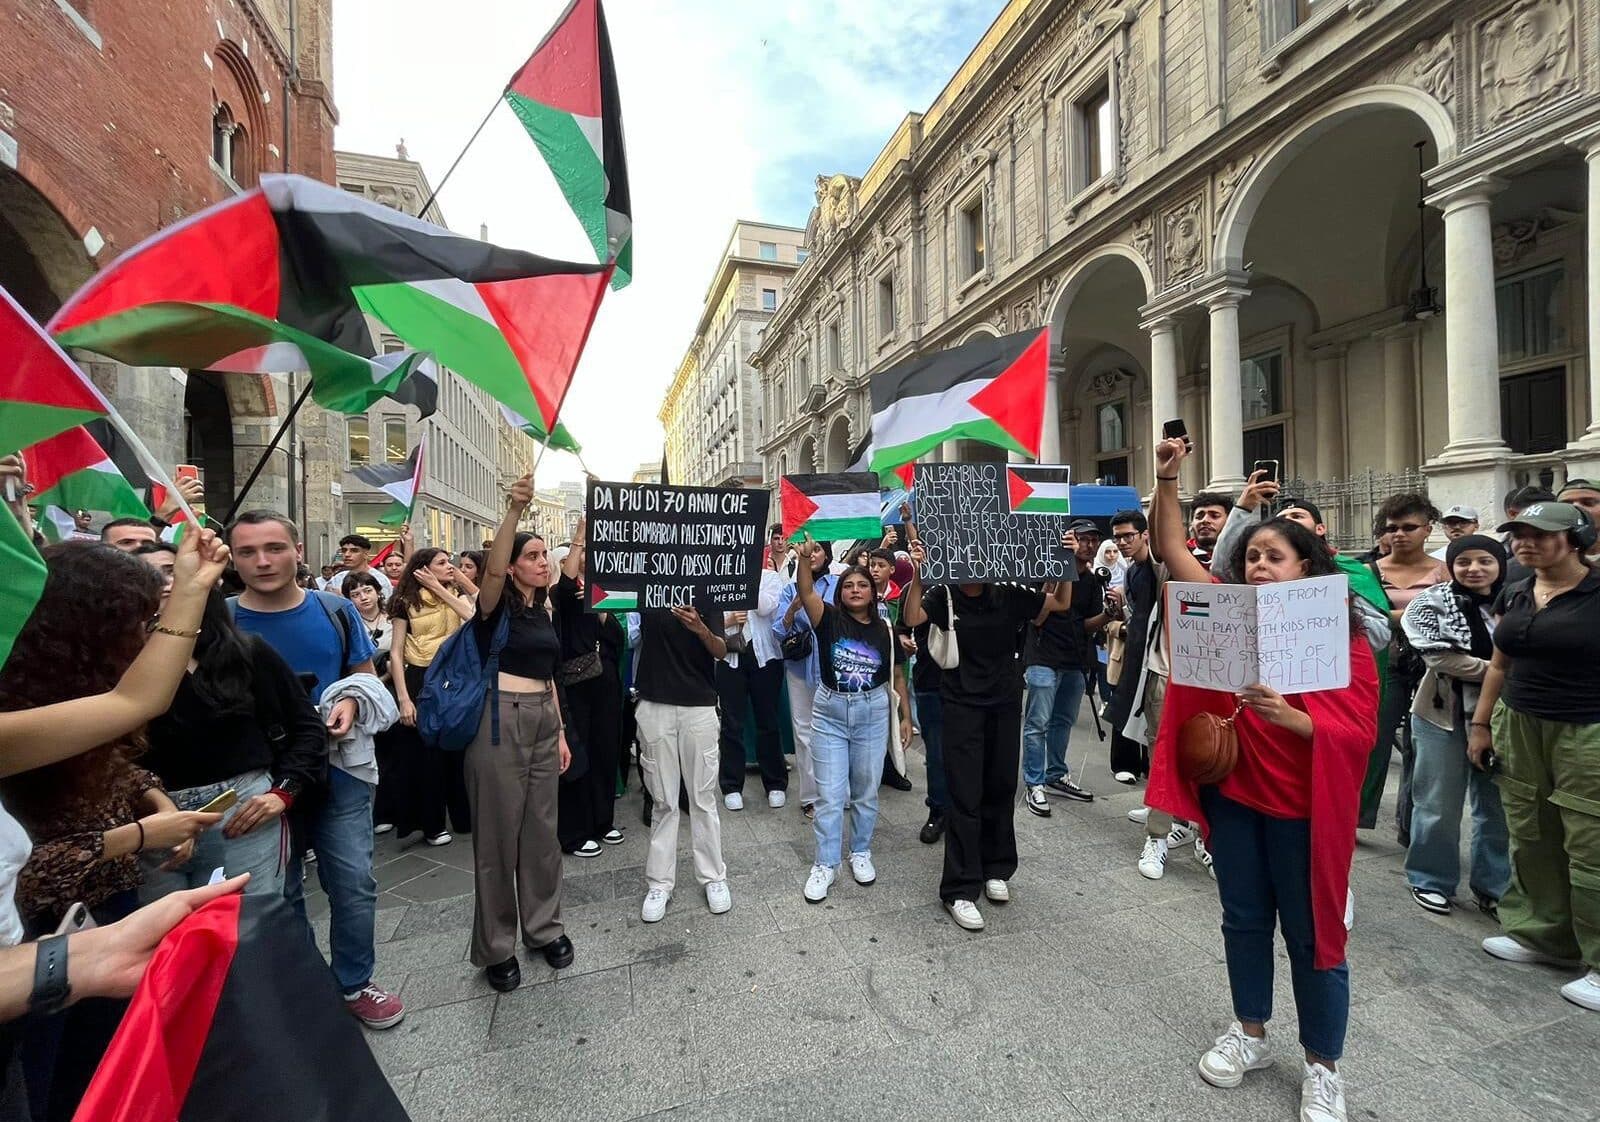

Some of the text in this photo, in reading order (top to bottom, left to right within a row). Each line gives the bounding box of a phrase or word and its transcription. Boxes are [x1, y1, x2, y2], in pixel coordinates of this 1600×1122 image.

[911, 465, 997, 482] UN BAMBINO
[914, 480, 998, 498] PALESTINESE
[594, 486, 614, 511] DA
[645, 490, 659, 512] DI
[663, 491, 684, 513] 70
[688, 492, 718, 514] ANNI
[721, 493, 749, 514] CHE
[915, 496, 953, 515] DISSE
[959, 495, 1000, 514] RAZZI
[917, 511, 1066, 531] POTREBBERO ESSERE
[593, 519, 629, 543] ISRAELE
[632, 521, 678, 545] BOMBARDA
[738, 524, 756, 545] VOI
[918, 529, 961, 547] SOPRA
[967, 528, 980, 546] DI
[1017, 528, 1037, 546] MA
[593, 550, 606, 574] VI
[651, 552, 678, 575] SOLO
[681, 553, 711, 576] ADESSO
[714, 553, 732, 576] CHE
[1035, 545, 1057, 562] CHE
[920, 560, 945, 580] DIO
[967, 560, 1011, 579] SOPRA
[1015, 560, 1026, 578] DI
[713, 592, 747, 604] MERDA
[1175, 585, 1328, 605] ONE DAY KIDS FROM
[1227, 602, 1285, 622] GAZA
[1176, 618, 1208, 632] WILL
[1212, 621, 1242, 634] PLAY
[1281, 620, 1305, 633] KIDS
[1307, 614, 1339, 631] FROM
[1195, 632, 1298, 652] NAZARETH
[1176, 643, 1326, 664] IN THE STREETS OF
[1174, 655, 1339, 688] JERUSALEM
